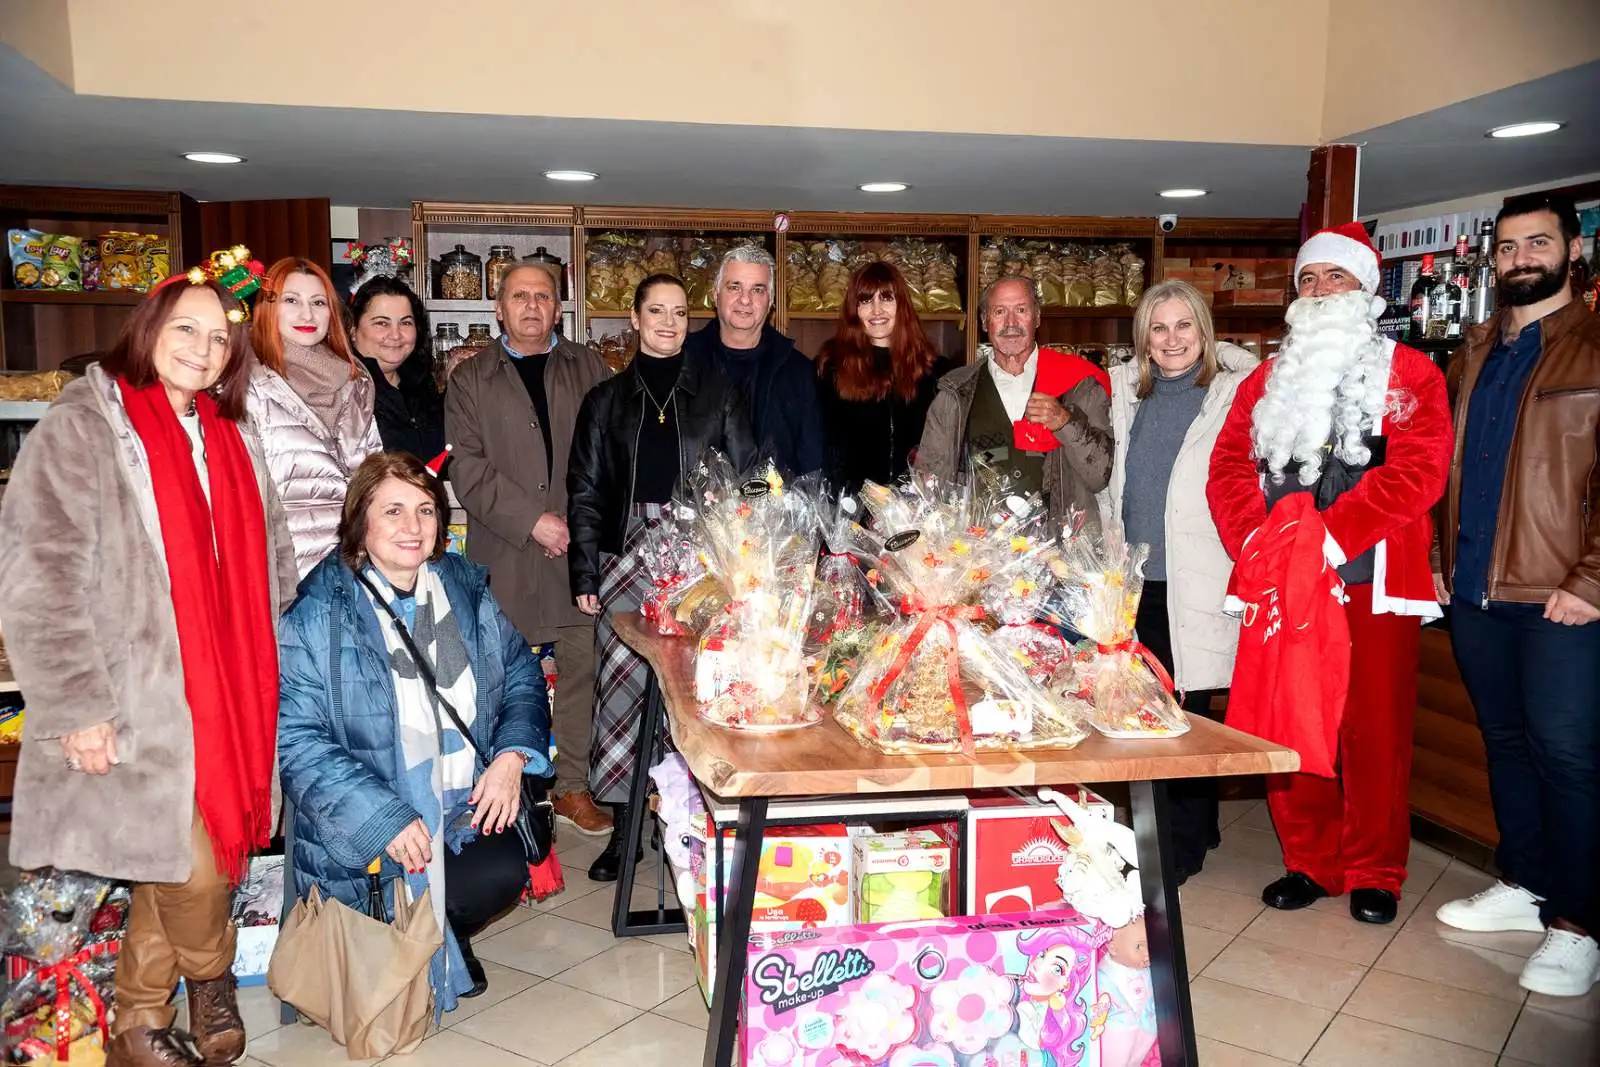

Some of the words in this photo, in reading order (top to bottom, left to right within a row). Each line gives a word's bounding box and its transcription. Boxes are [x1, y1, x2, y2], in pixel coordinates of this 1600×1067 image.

[766, 907, 784, 917] Uga
[754, 950, 868, 1003] Sbelletti
[778, 989, 825, 1009] make-up
